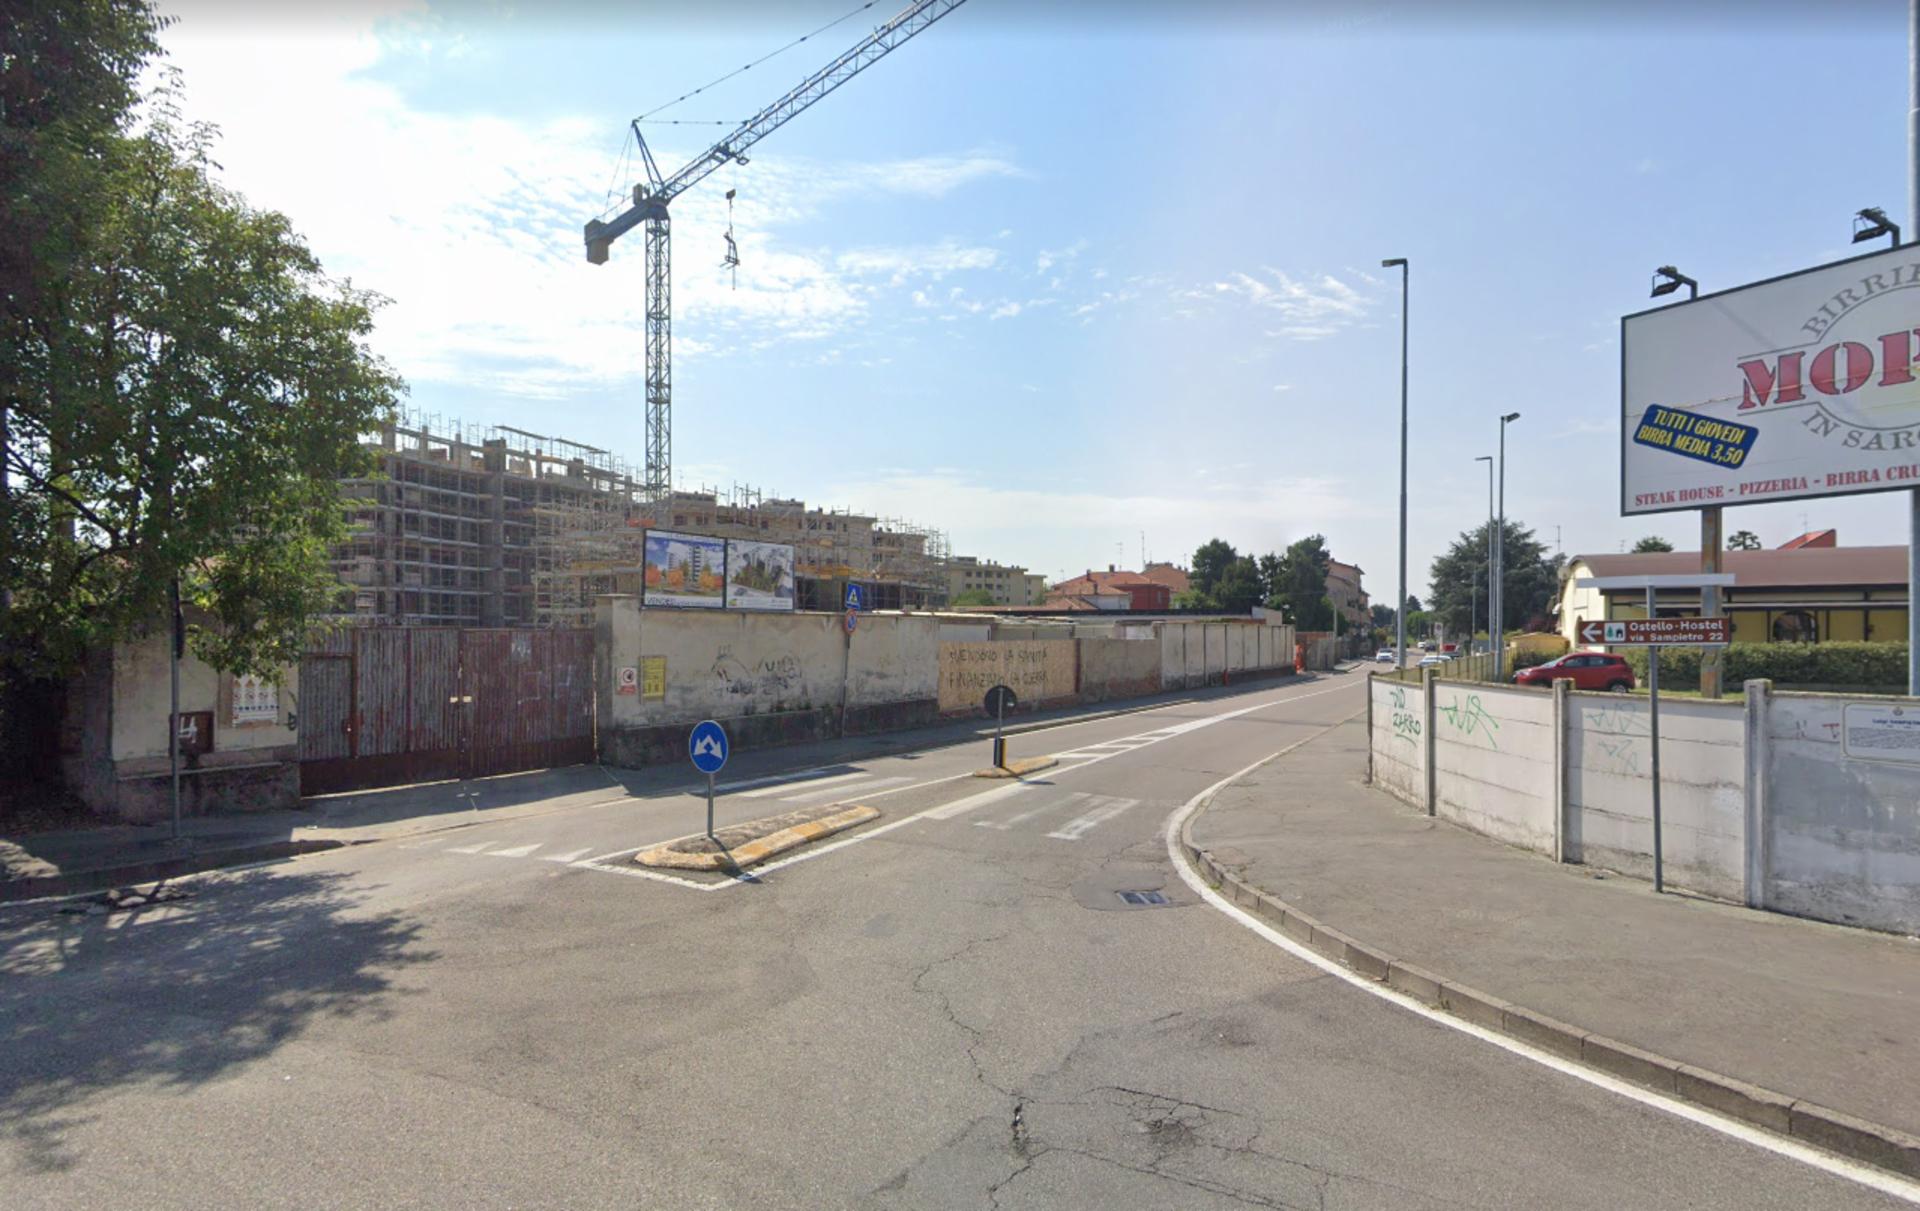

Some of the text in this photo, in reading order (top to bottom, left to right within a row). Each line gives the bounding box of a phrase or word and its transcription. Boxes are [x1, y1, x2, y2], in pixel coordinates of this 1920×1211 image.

[1653, 408, 1688, 430] TUTTI
[1801, 410, 1920, 451] IN SAR
[1637, 424, 1745, 465] BIRRA MEDIA 3,50
[1635, 490, 1675, 507] STEAK
[1679, 485, 1724, 501] HOUSE
[1739, 476, 1808, 495] PIZZERIA
[1826, 468, 1880, 487] BIRRA
[1630, 633, 1644, 642] via
[1709, 632, 1723, 641] 22
